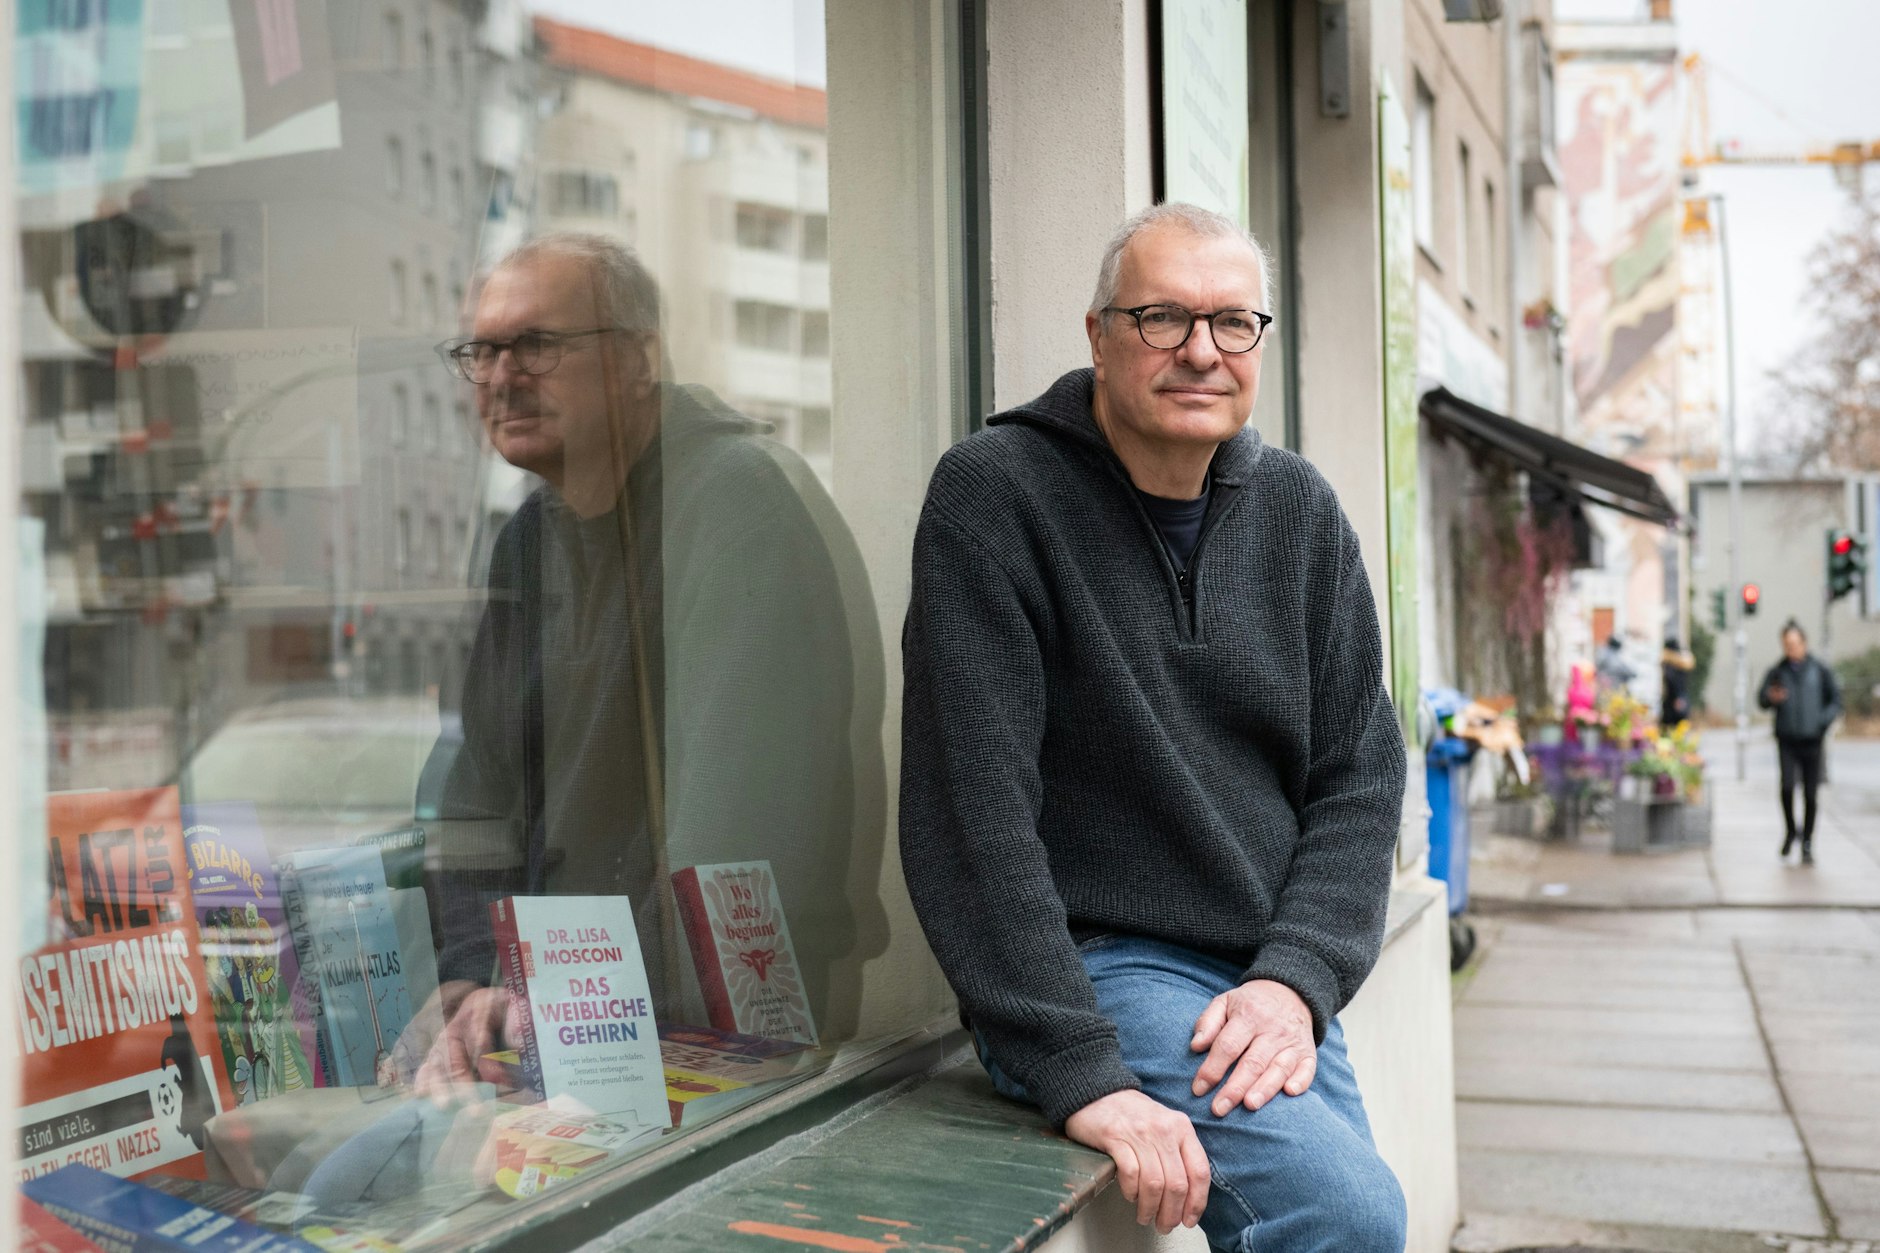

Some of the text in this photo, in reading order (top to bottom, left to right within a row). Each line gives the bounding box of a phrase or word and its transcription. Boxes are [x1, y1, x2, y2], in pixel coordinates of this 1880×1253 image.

[398, 831, 424, 848] VERLAG
[48, 824, 182, 938] LATZ FÜR
[191, 840, 264, 900] BIZARRE
[730, 885, 752, 901] Wo
[731, 904, 761, 920] alles
[546, 927, 611, 945] DR. LISA
[725, 921, 777, 942] beginnt
[543, 947, 623, 965] MOSCONI
[509, 943, 525, 994] GEHIRN
[16, 929, 198, 1056] ISEMITISMUS
[569, 977, 610, 998] DAS
[539, 998, 648, 1023] WEIBLICHE
[519, 998, 539, 1071] WEIBLICHE
[558, 1023, 638, 1046] GEHIRN
[25, 1124, 53, 1152] sind
[58, 1115, 96, 1142] viele.
[117, 1127, 161, 1164] NAZIS
